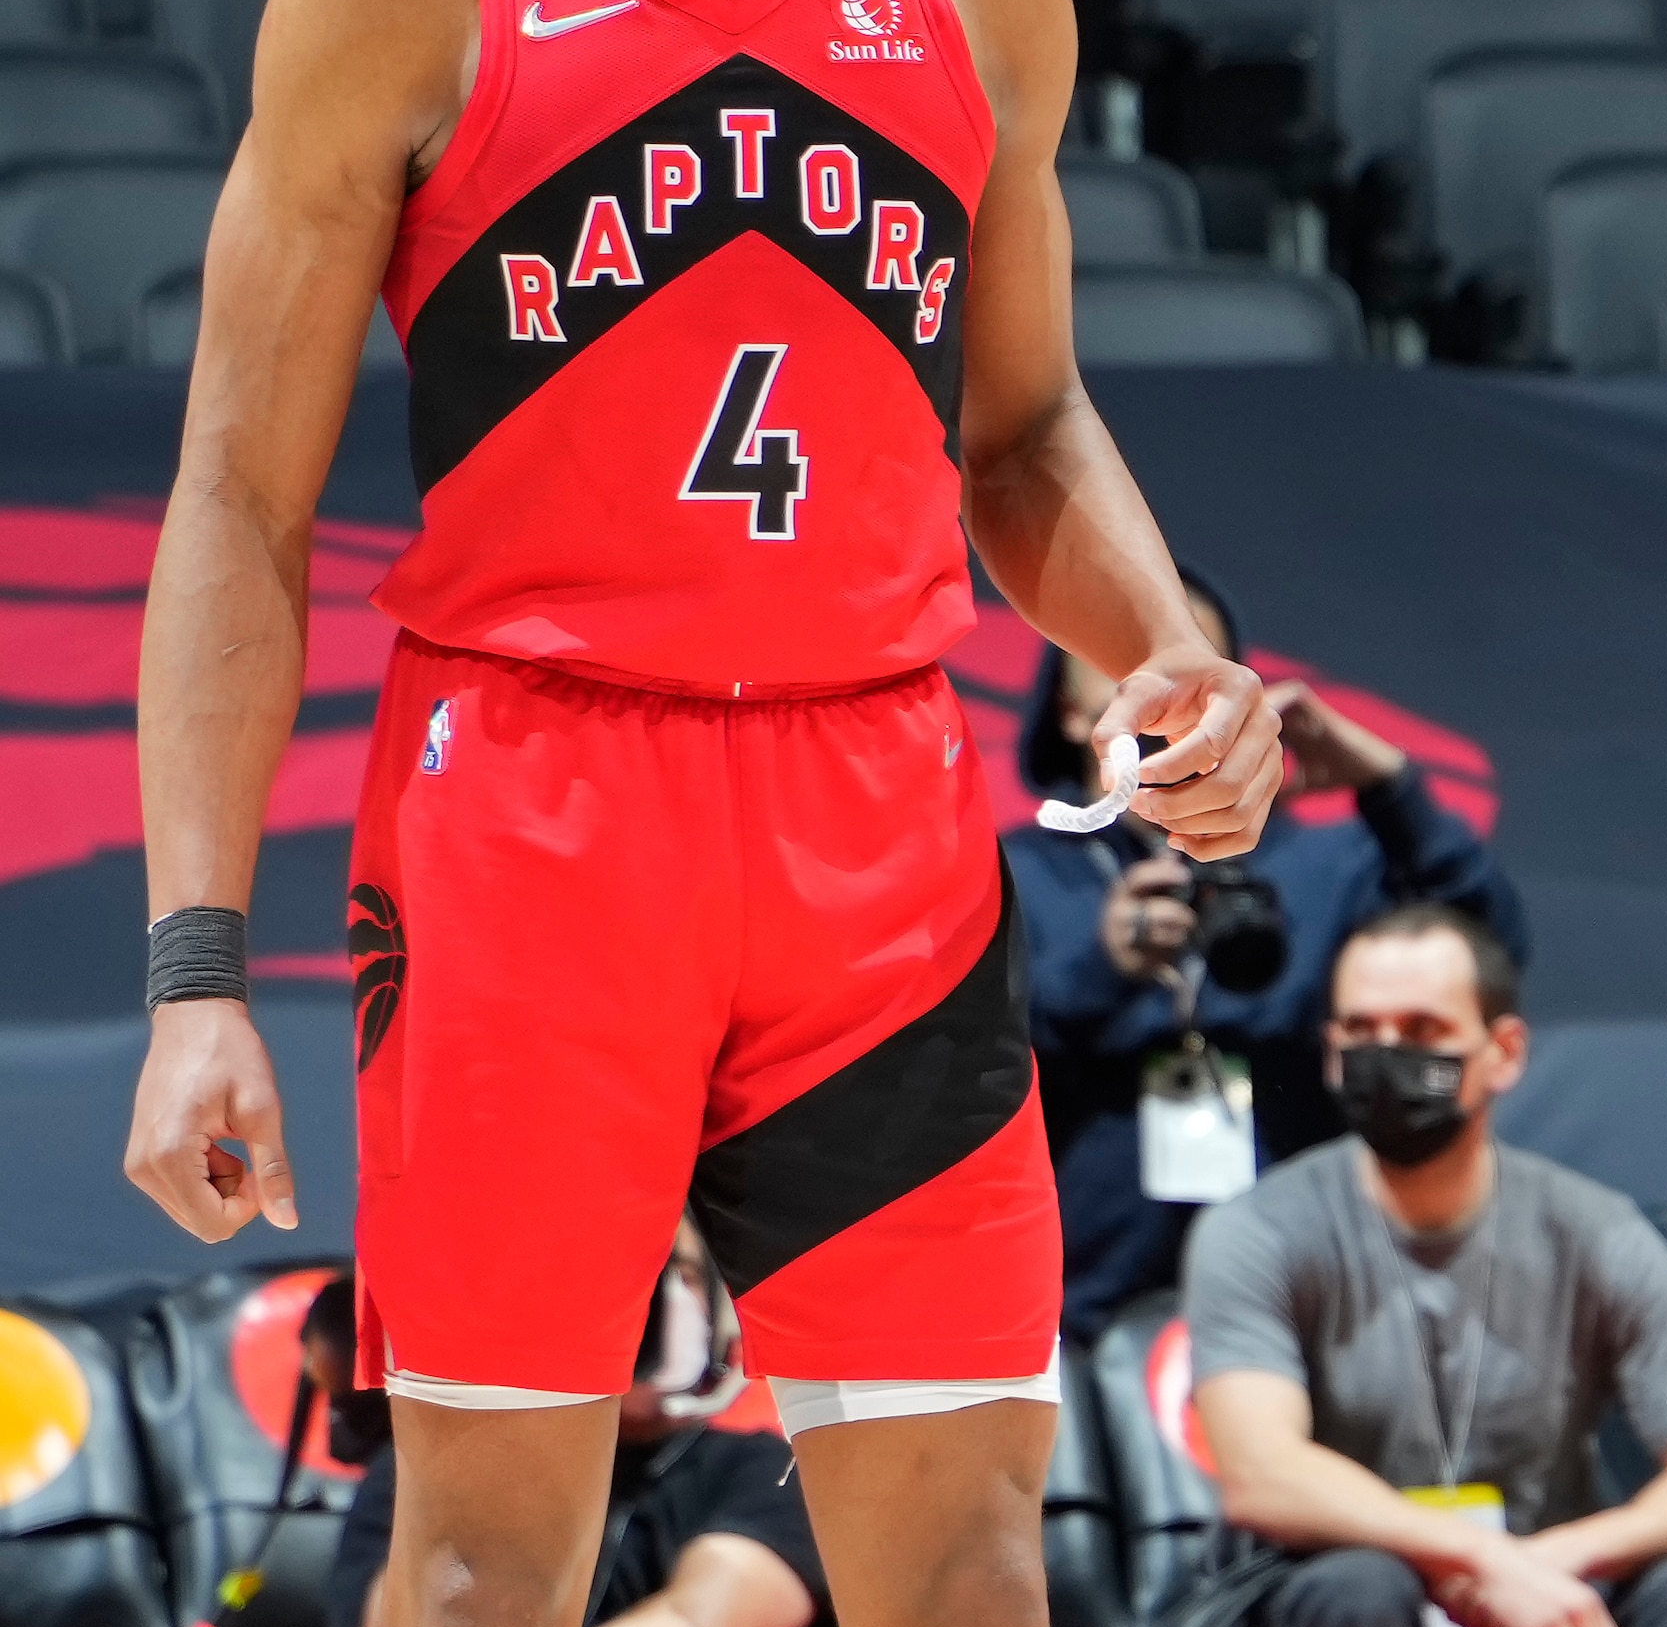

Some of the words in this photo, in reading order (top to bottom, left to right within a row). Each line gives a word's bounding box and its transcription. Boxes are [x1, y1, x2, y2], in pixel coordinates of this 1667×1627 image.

[829, 40, 877, 61] Sun
[881, 39, 925, 61] Life
[502, 109, 954, 343] RAPTORS
[678, 343, 809, 540] 4
